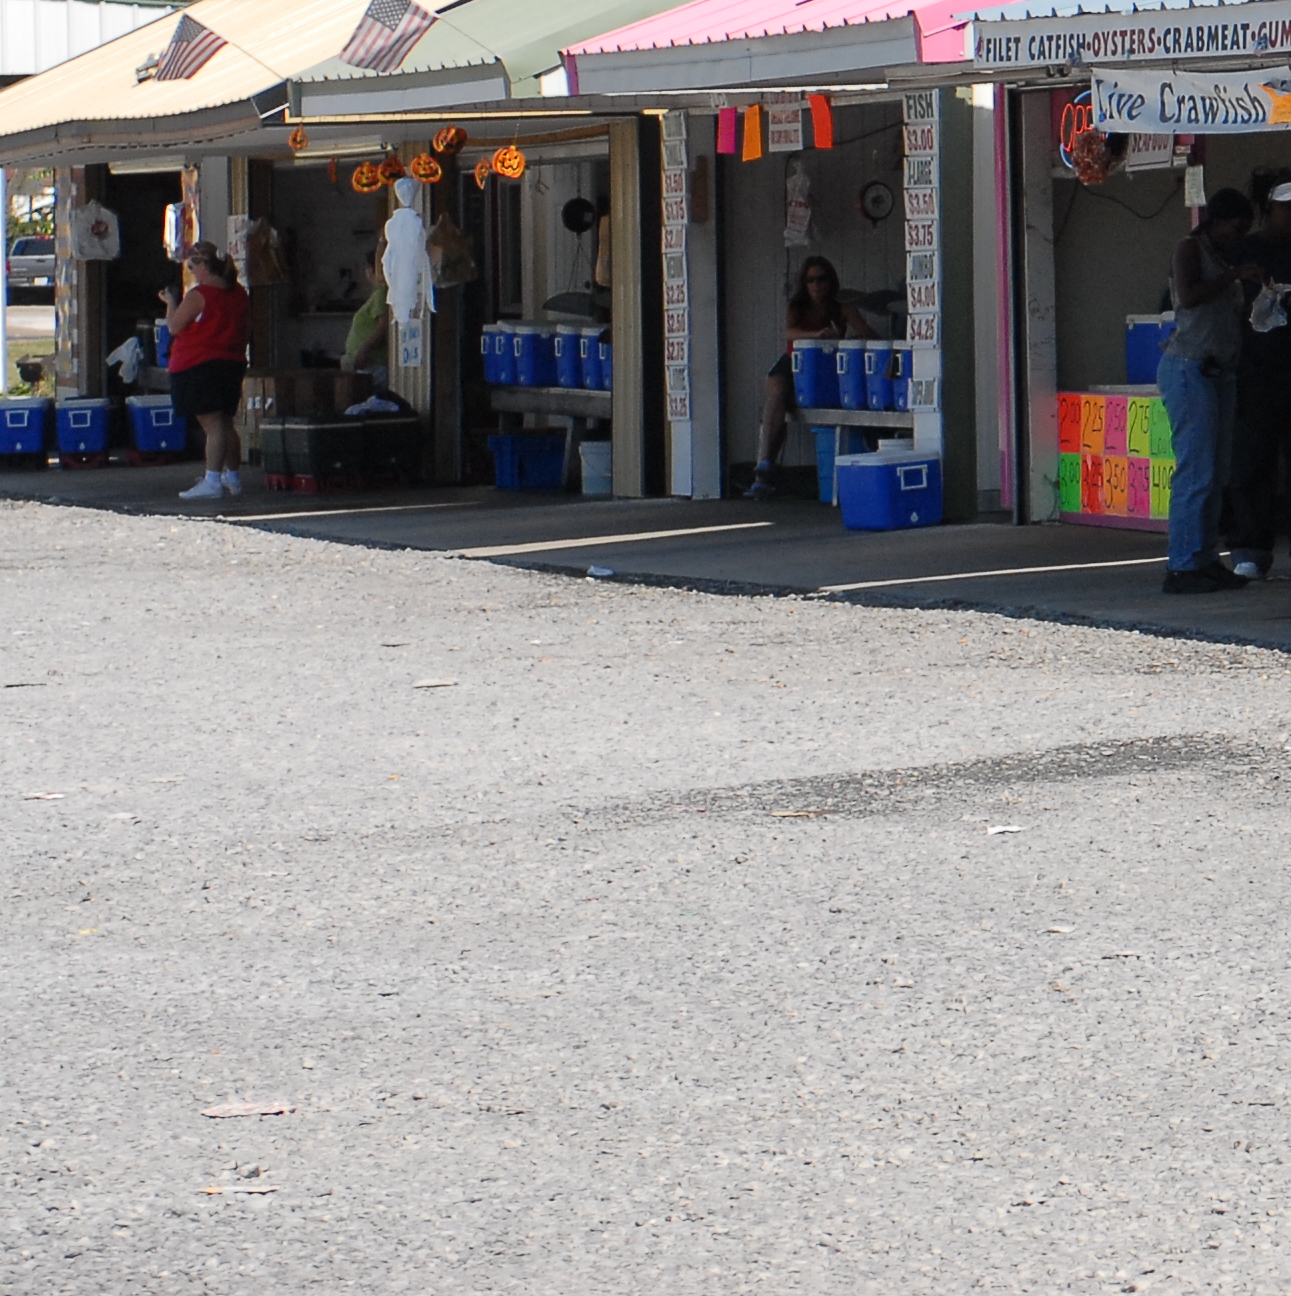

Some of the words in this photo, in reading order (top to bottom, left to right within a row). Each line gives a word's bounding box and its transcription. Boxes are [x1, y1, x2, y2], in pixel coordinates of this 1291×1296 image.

[986, 36, 1021, 63] FILET
[1028, 32, 1086, 61] CATFISH
[1091, 27, 1157, 57] OYSTERS
[1163, 22, 1250, 54] CRABMEAT
[905, 93, 934, 120] FISH
[1095, 79, 1146, 122] Live
[1159, 80, 1267, 125] Crawfish
[907, 128, 934, 151] $3.00
[908, 224, 934, 246] $3.75
[911, 317, 935, 341] $4.25
[666, 341, 685, 361] $2.75
